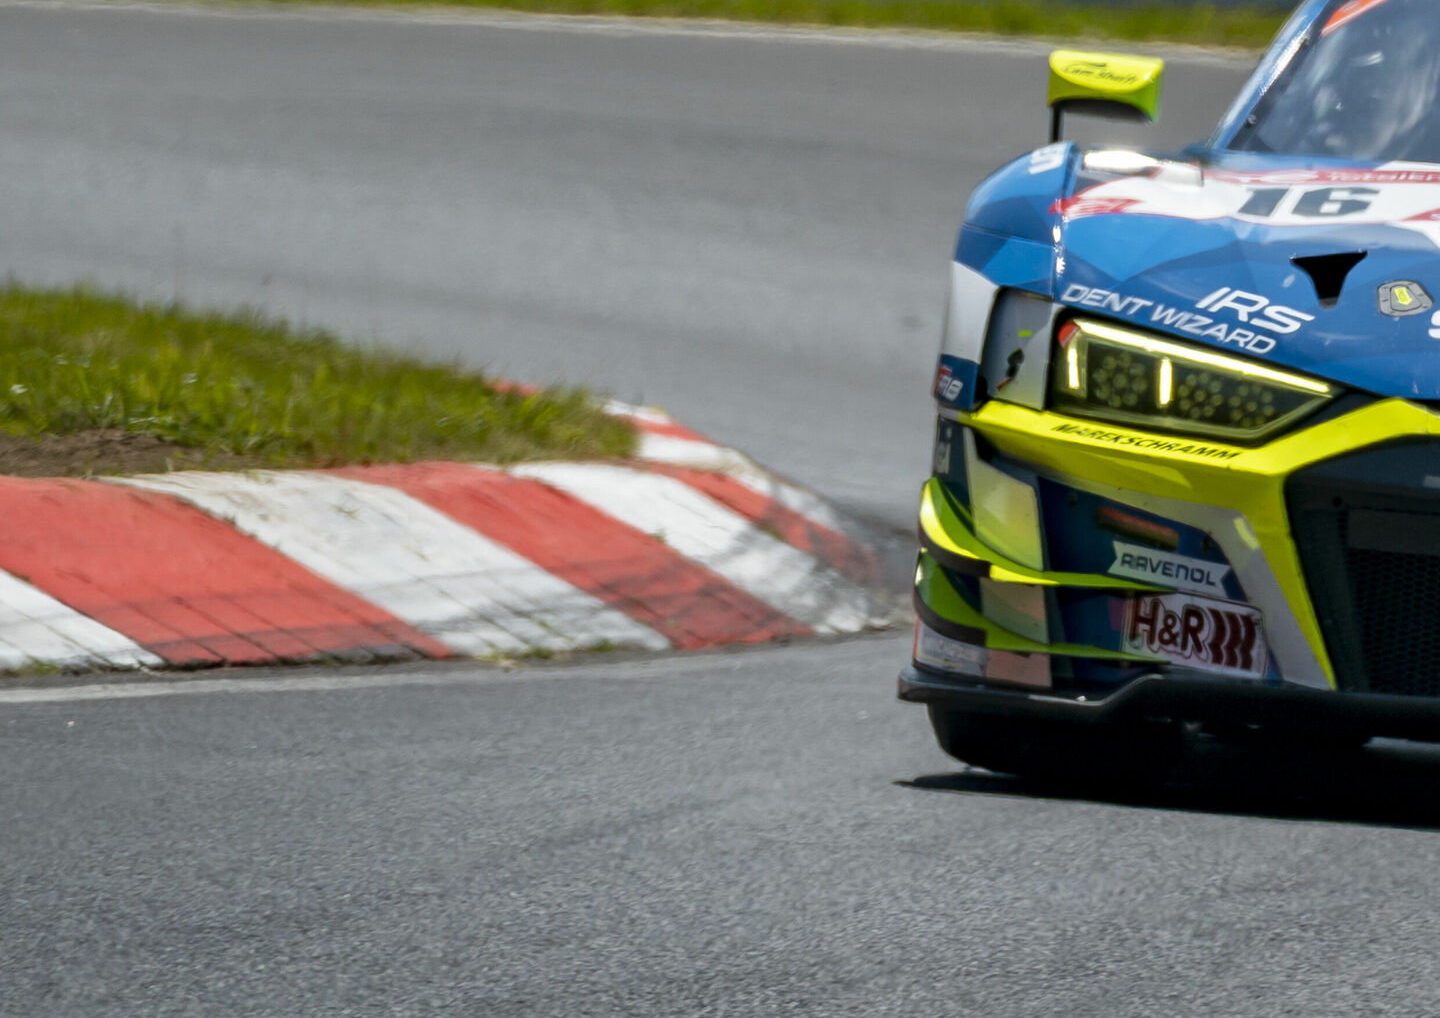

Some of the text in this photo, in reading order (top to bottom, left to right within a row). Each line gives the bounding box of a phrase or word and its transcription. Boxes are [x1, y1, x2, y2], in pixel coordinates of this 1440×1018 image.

[1237, 187, 1382, 218] 16
[1061, 283, 1277, 355] DENT WIZARD
[1196, 287, 1315, 334] IRS
[1050, 423, 1242, 461] MAREKSCHRAMM
[1120, 551, 1216, 587] RAVENOL
[1130, 596, 1206, 655] H&R
